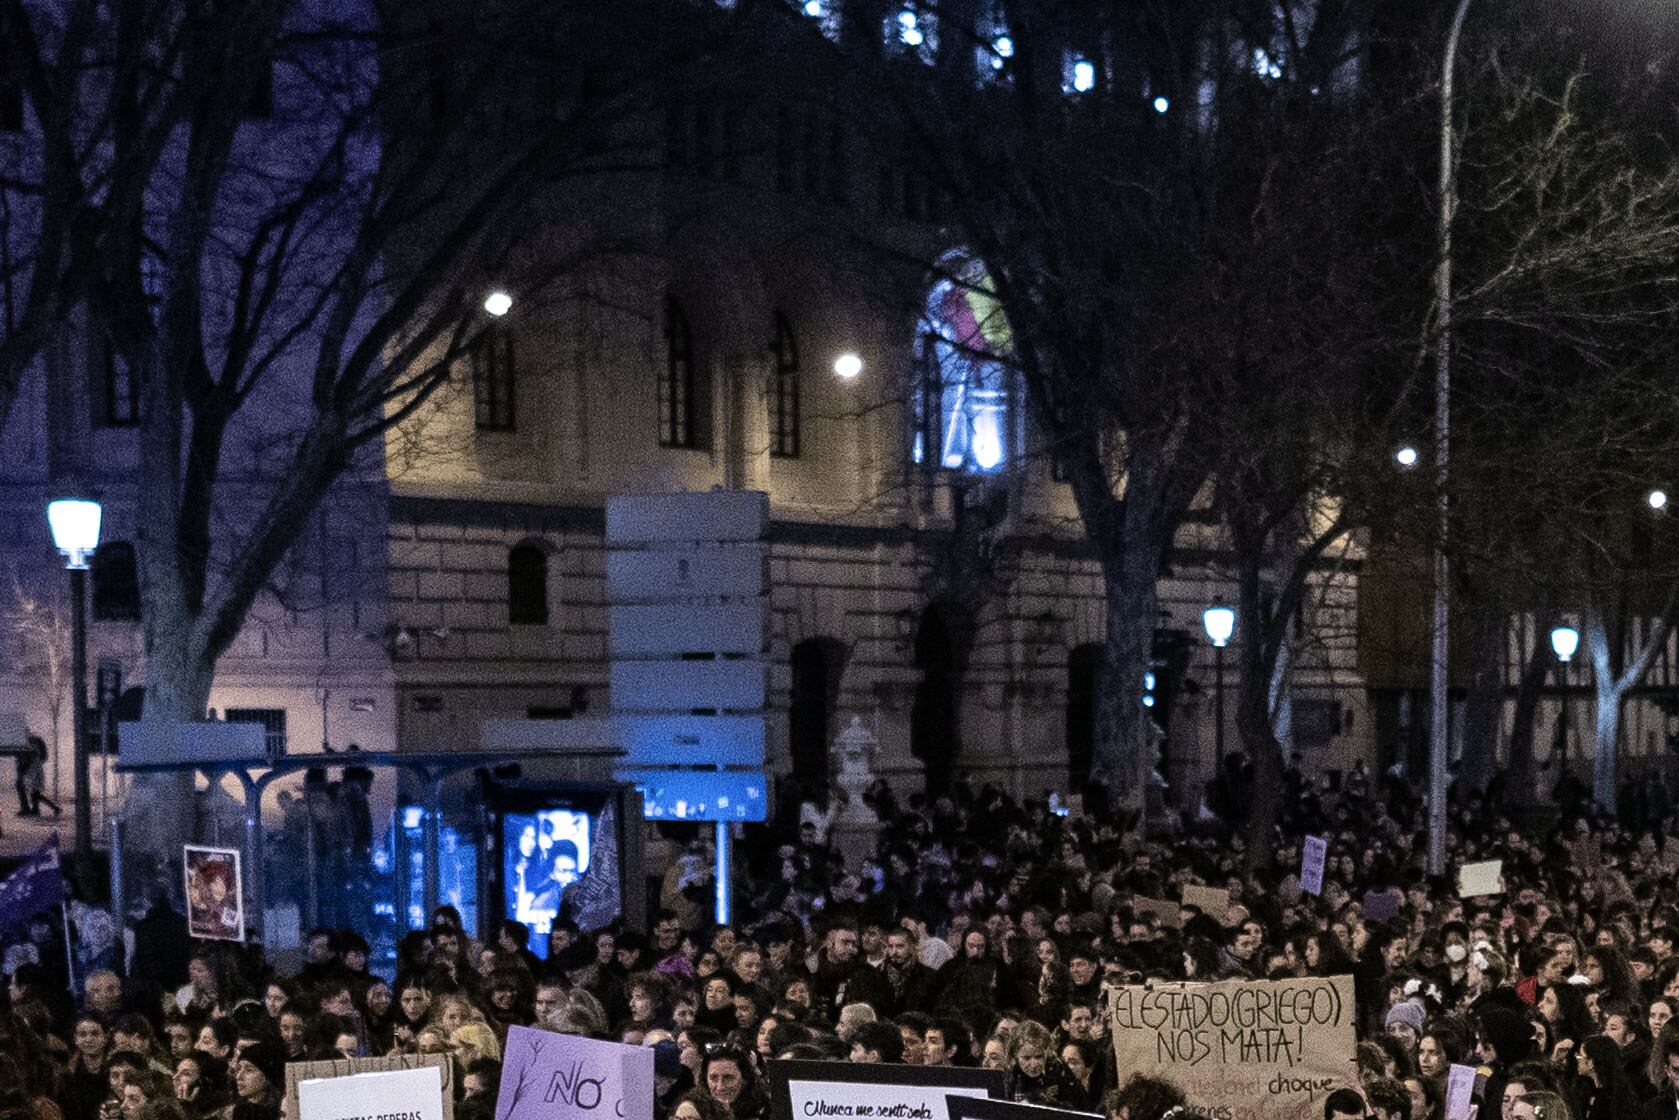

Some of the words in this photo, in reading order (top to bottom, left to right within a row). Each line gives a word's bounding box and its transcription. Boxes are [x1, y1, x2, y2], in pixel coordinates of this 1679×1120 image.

[1116, 989, 1142, 1029] EL
[1141, 989, 1229, 1030] ESTADO
[1157, 1029, 1211, 1066] NOS
[1221, 1026, 1303, 1067] MATA!
[544, 1060, 607, 1110] NO
[1269, 1073, 1334, 1101] choque
[804, 1100, 854, 1116] Nunca
[855, 1105, 875, 1116] me
[908, 1103, 933, 1120] sola
